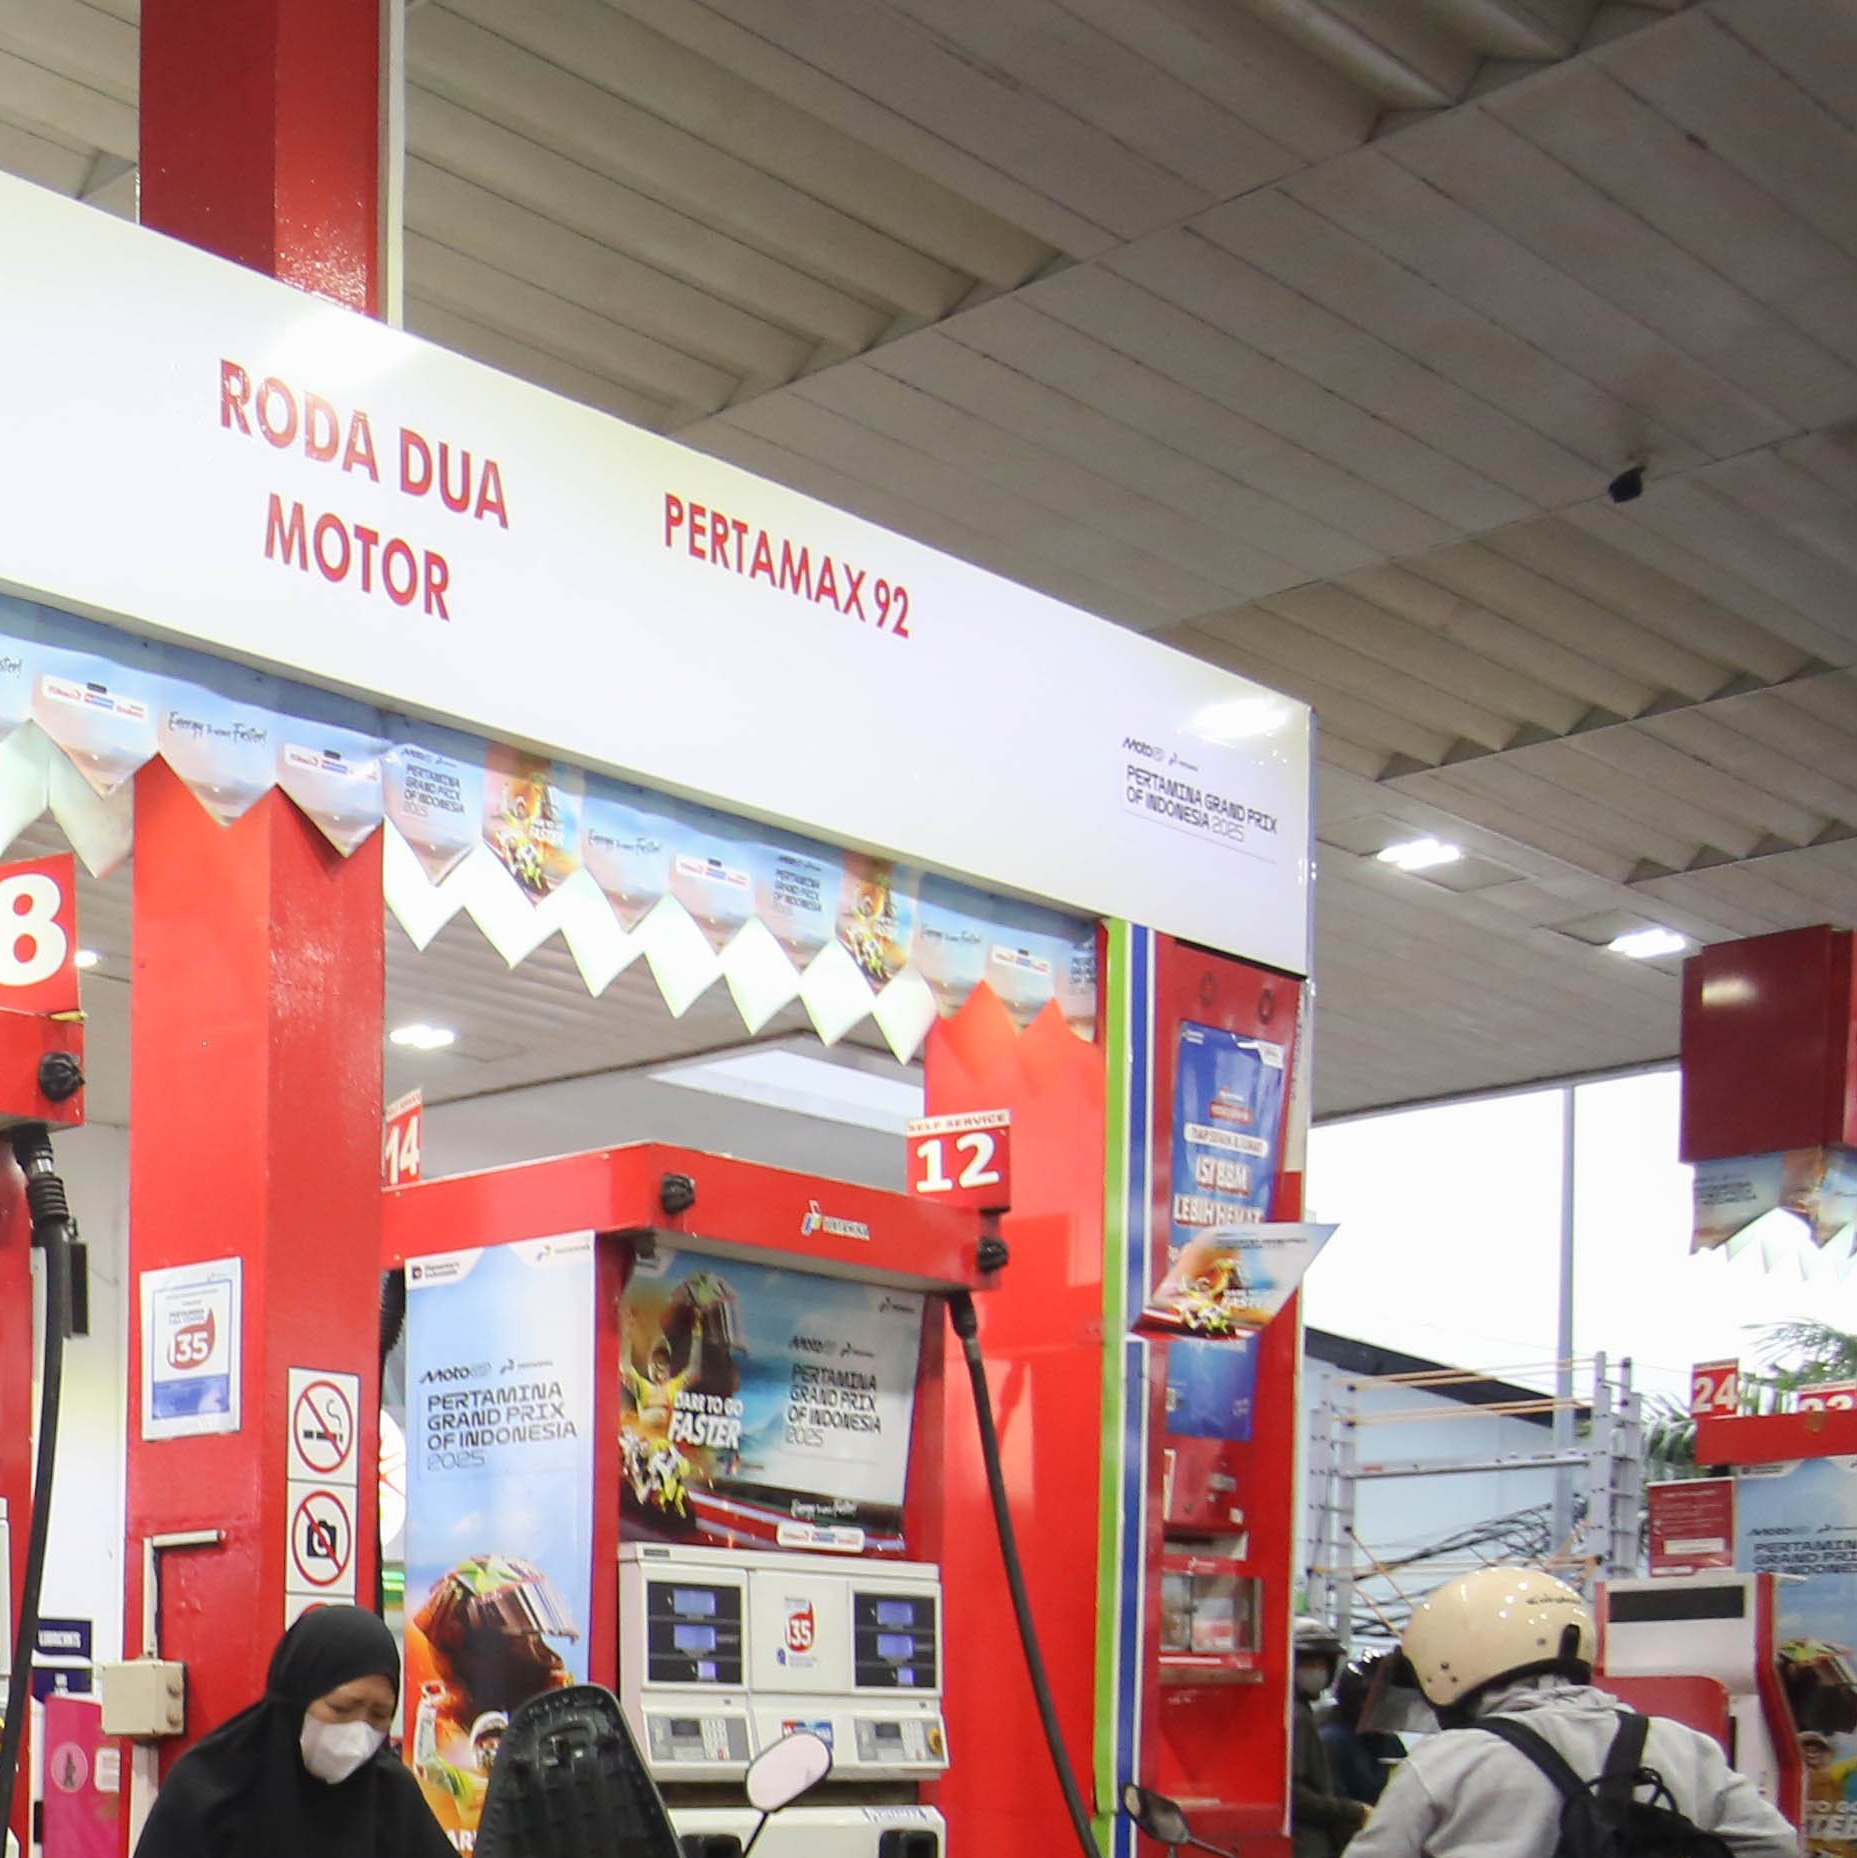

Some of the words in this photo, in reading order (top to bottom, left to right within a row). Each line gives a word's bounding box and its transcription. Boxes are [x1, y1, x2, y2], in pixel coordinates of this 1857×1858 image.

[219, 359, 380, 483] RODA
[399, 425, 510, 530] DUA
[263, 492, 452, 621] MOTOR
[664, 491, 869, 622] PERTAMAX
[873, 576, 911, 639] 92
[1126, 764, 1203, 807] PERTAMINA
[1204, 792, 1246, 823] GRAND
[1247, 807, 1278, 834] PRIX
[1126, 785, 1145, 806] OF
[1145, 790, 1210, 829] INDONESIA
[384, 1115, 421, 1185] 14
[915, 1131, 1001, 1193] 12
[168, 1331, 209, 1365] 135
[427, 1380, 563, 1411] PERTAMINA
[427, 1405, 501, 1432] GRAND
[505, 1401, 566, 1424] PRIX
[1694, 1374, 1738, 1415] 24
[427, 1430, 455, 1452] OF
[459, 1418, 578, 1447] INDONESIA
[668, 1411, 744, 1450] FASTER
